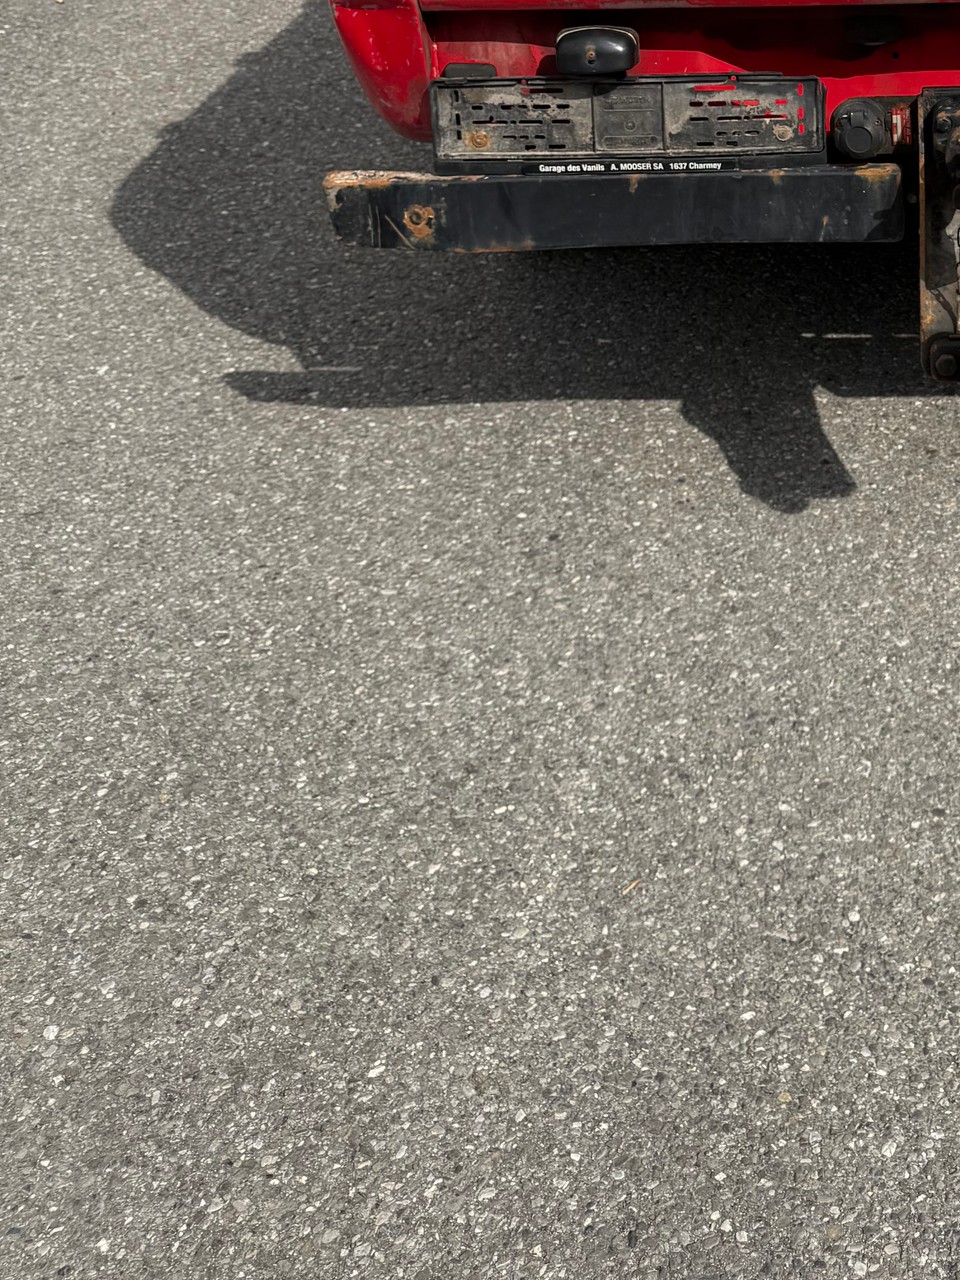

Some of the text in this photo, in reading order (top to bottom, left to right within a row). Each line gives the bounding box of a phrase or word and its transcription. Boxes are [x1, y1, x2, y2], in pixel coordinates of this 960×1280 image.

[539, 162, 722, 173] Garage des Vanils A. MOOSER SA 1637 Charmey
